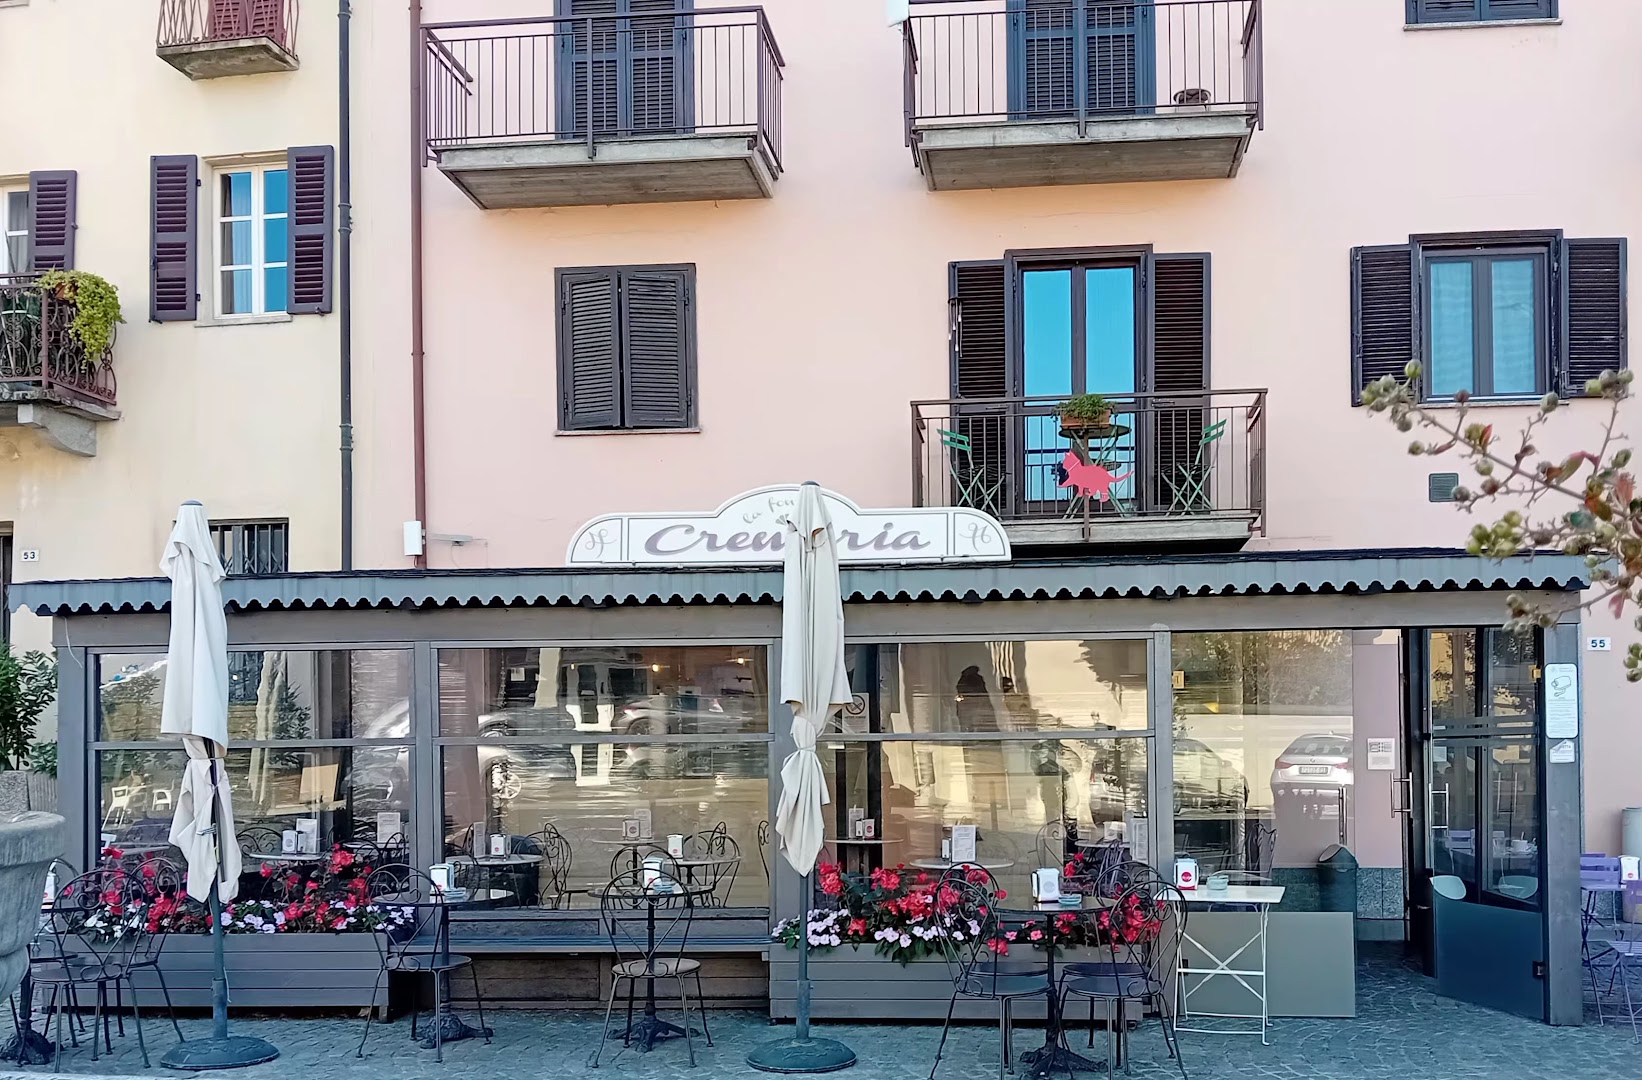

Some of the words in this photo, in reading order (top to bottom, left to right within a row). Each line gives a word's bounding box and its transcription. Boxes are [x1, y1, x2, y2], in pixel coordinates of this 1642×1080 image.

[742, 512, 762, 524] la
[644, 522, 931, 556] Cremria
[23, 551, 36, 560] 53
[1591, 639, 1606, 648] 55
